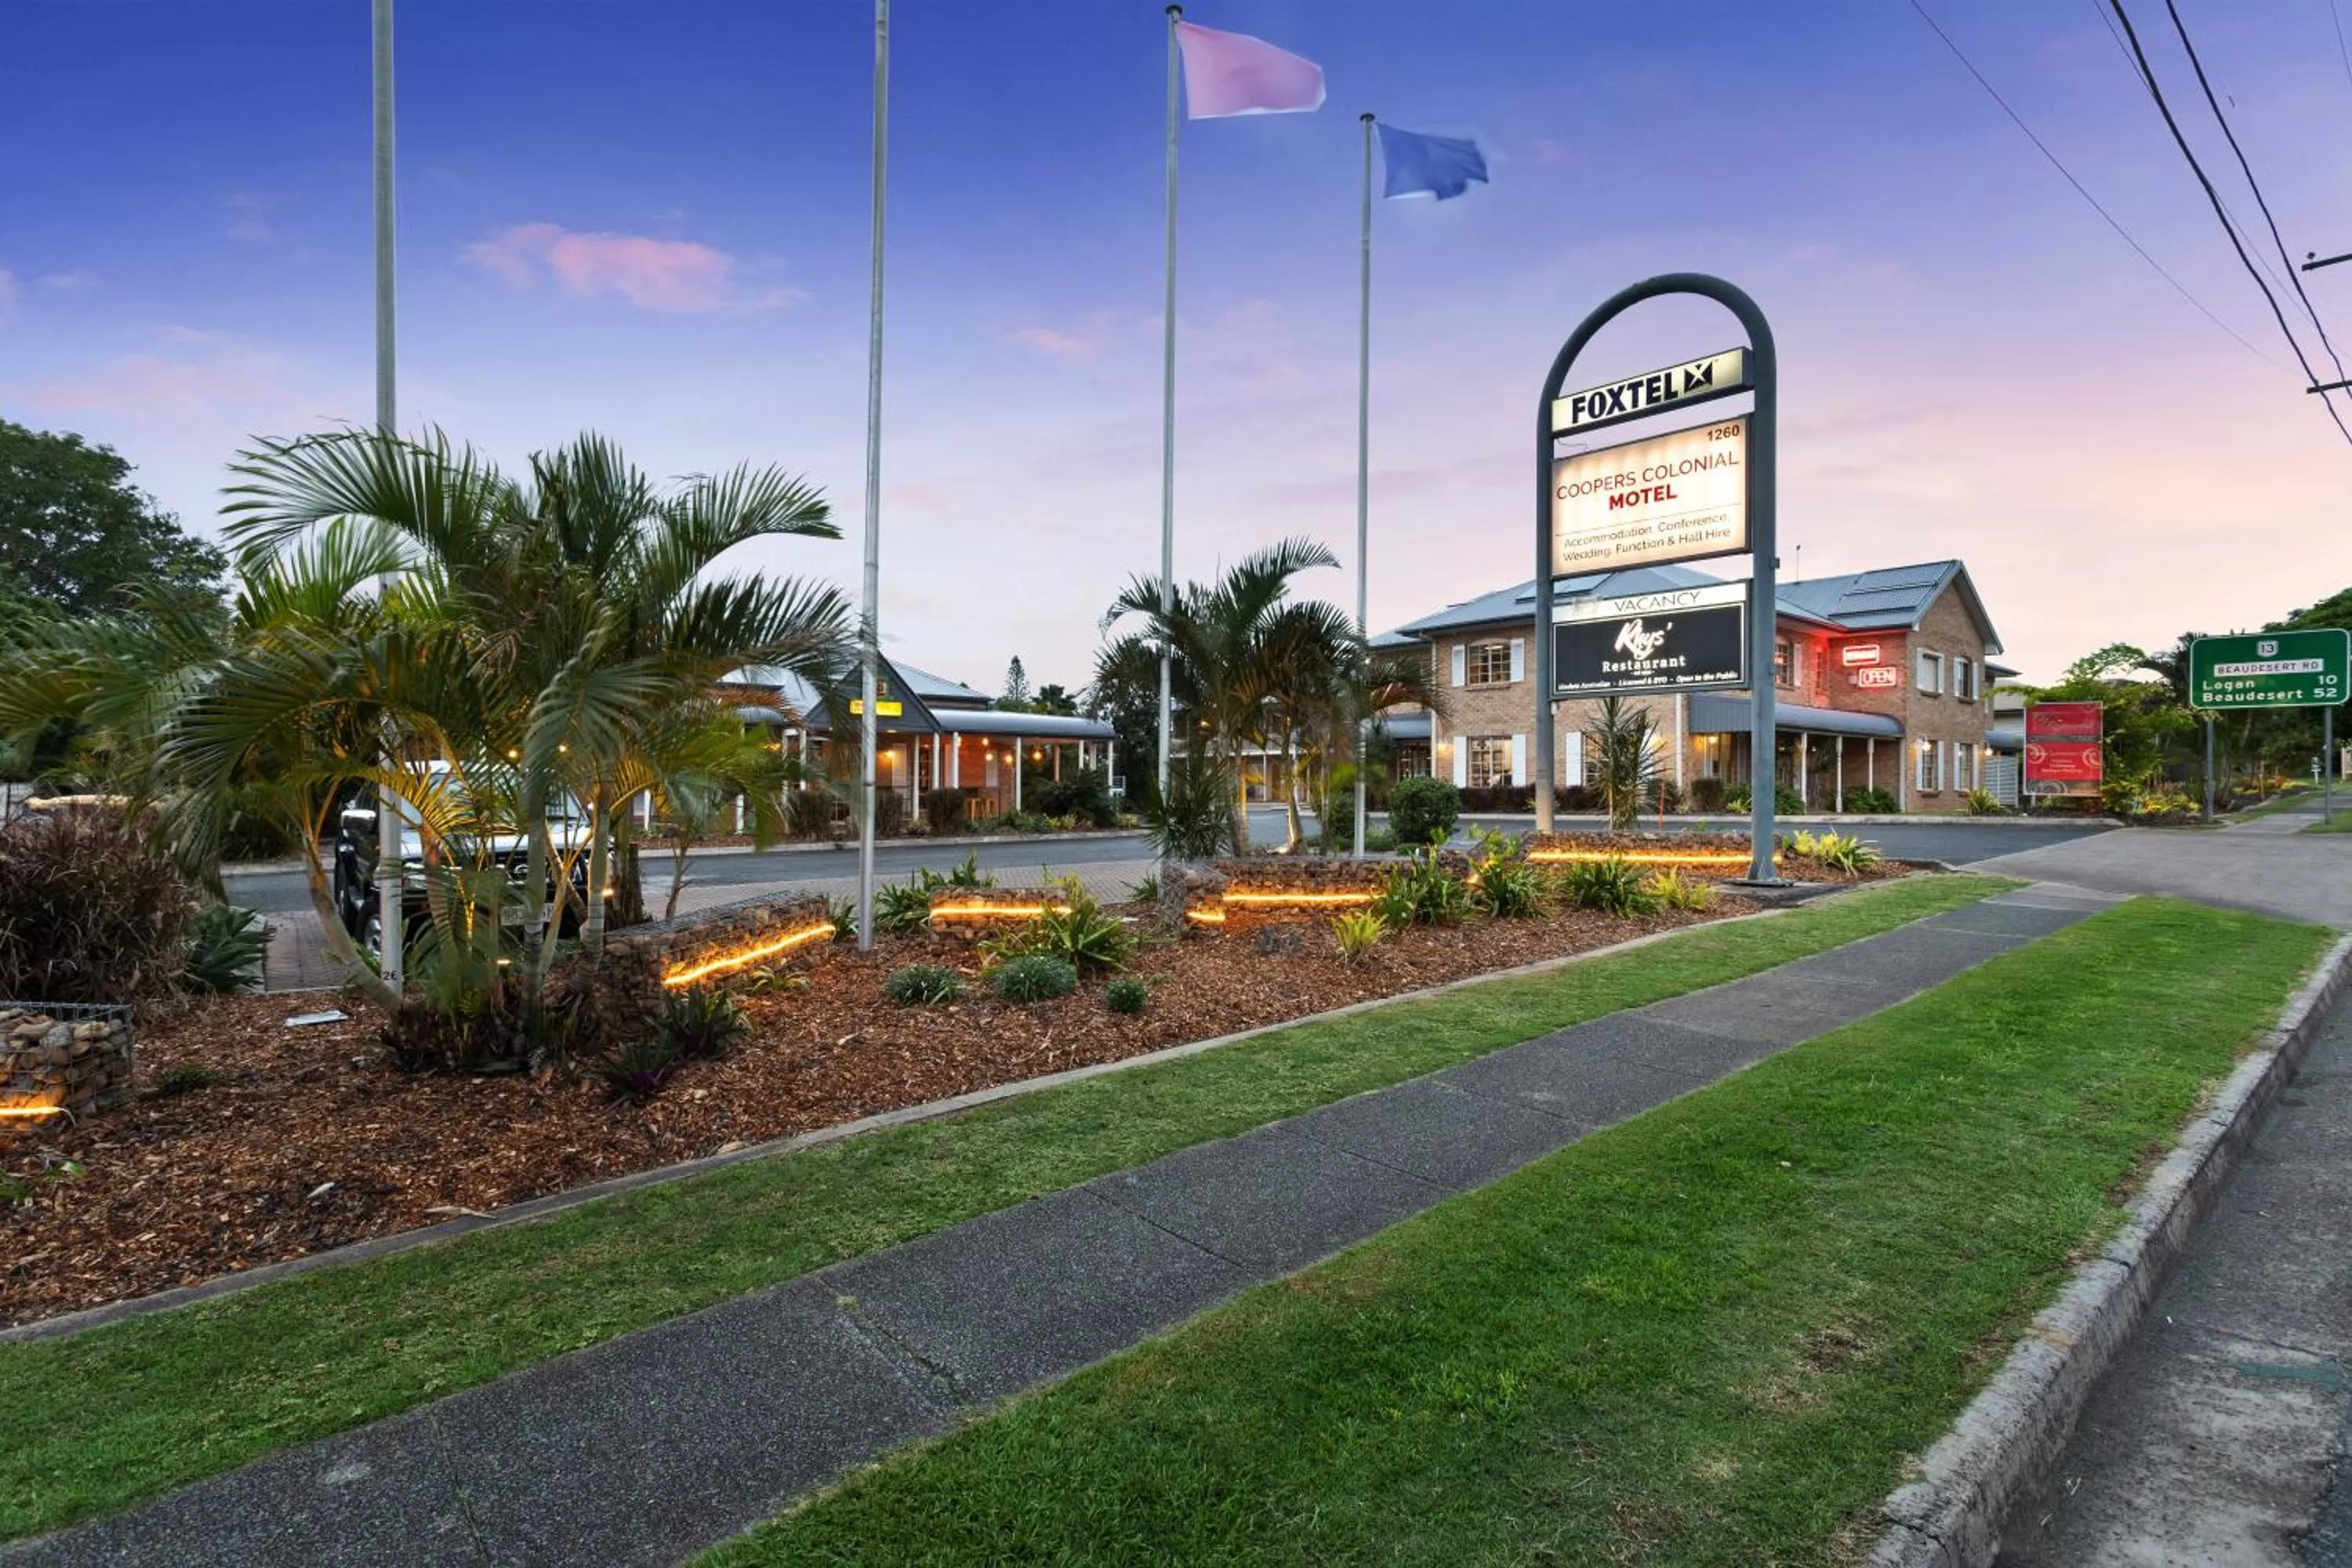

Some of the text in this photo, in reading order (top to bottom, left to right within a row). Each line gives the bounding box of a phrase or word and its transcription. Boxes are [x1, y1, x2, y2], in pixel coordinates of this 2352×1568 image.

[1572, 372, 1678, 423] FOXTEL
[1707, 425, 1740, 441] 1260
[1556, 451, 1739, 499] COOPERS COLONIAL
[1609, 484, 1678, 510] MOTEL
[1616, 538, 1664, 554] Function
[1668, 535, 1675, 546] &
[1679, 530, 1702, 543] Hall
[1705, 528, 1731, 540] Hire
[1615, 591, 1700, 612] VACANCY
[2261, 644, 2274, 653] 13
[1602, 655, 1686, 673] Restaurant
[2218, 661, 2318, 674] BEAUDESERT RD
[1862, 670, 1893, 684] OPEN
[2202, 675, 2338, 691] Logan 10
[2202, 688, 2338, 702] Beaudesert 52
